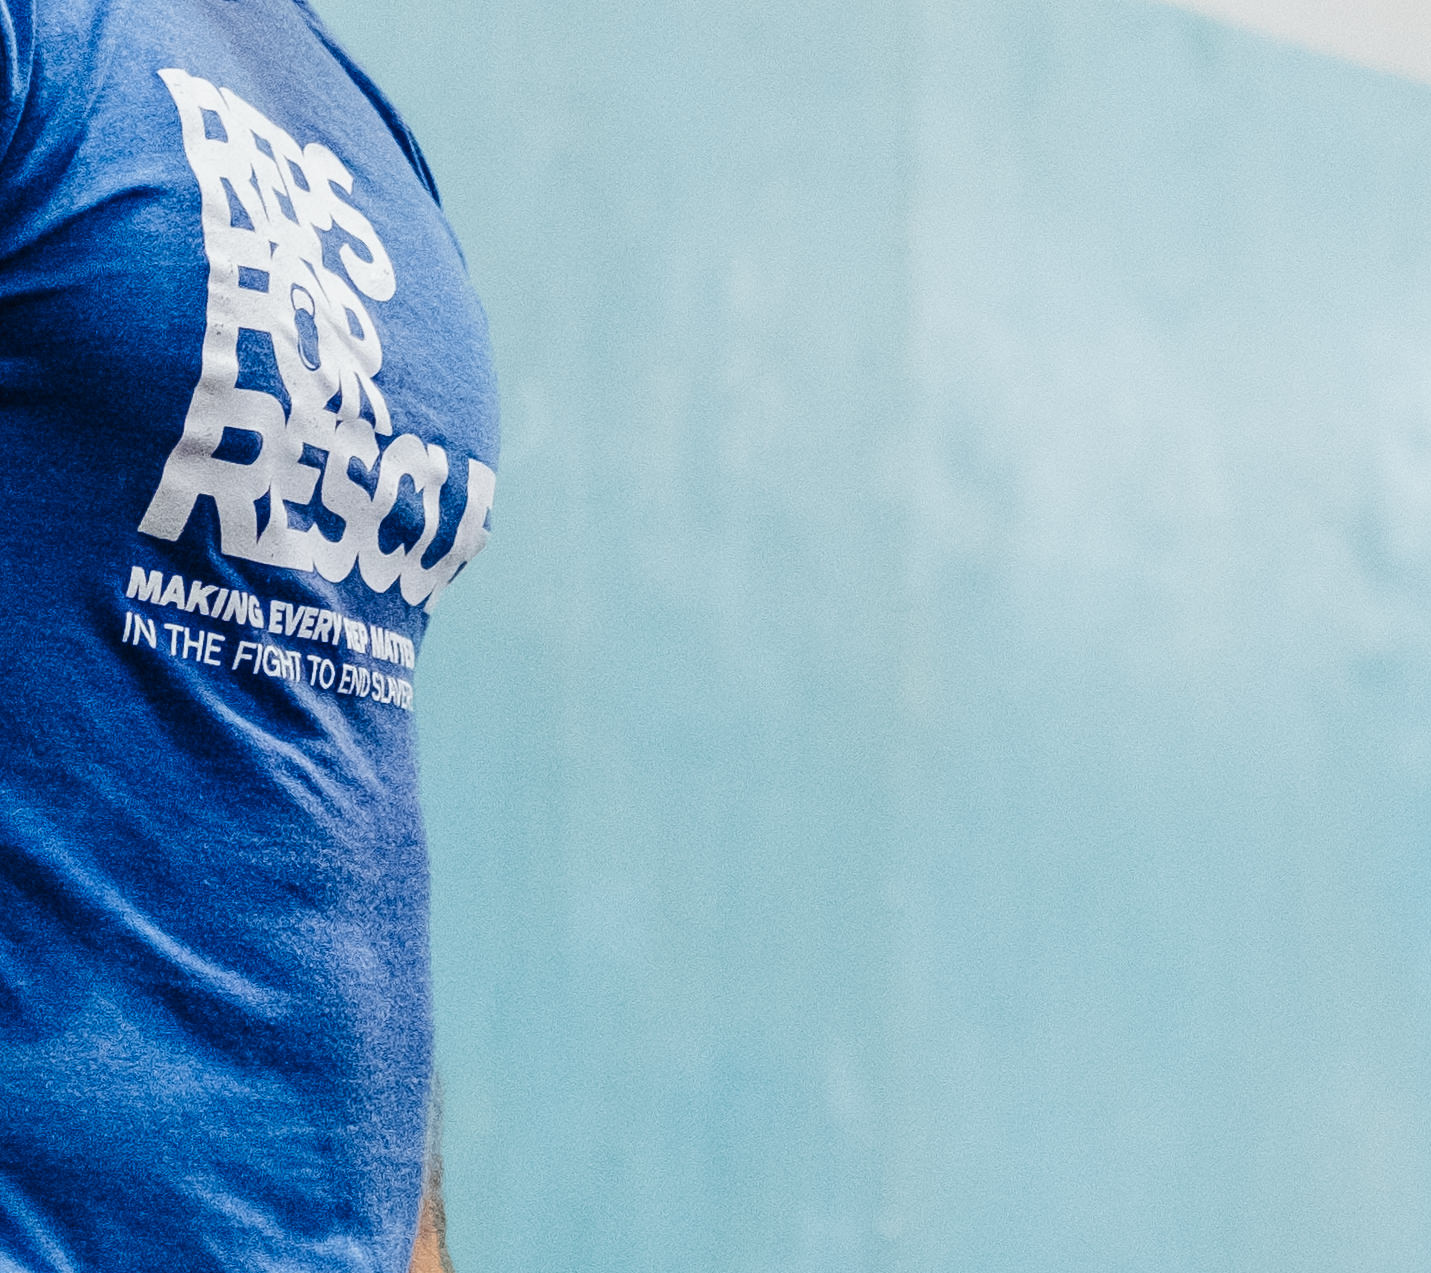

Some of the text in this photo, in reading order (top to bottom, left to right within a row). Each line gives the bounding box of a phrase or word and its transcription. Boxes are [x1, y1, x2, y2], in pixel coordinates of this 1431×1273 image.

[157, 67, 396, 302] REPS
[202, 224, 393, 436] FOR
[122, 611, 157, 649] IN
[164, 623, 226, 666] THE
[231, 640, 303, 684] FIGHT
[306, 654, 336, 690] TO
[336, 662, 371, 698] END
[126, 566, 265, 629] MAKING
[268, 600, 344, 645] EVERY
[343, 617, 369, 654] REP
